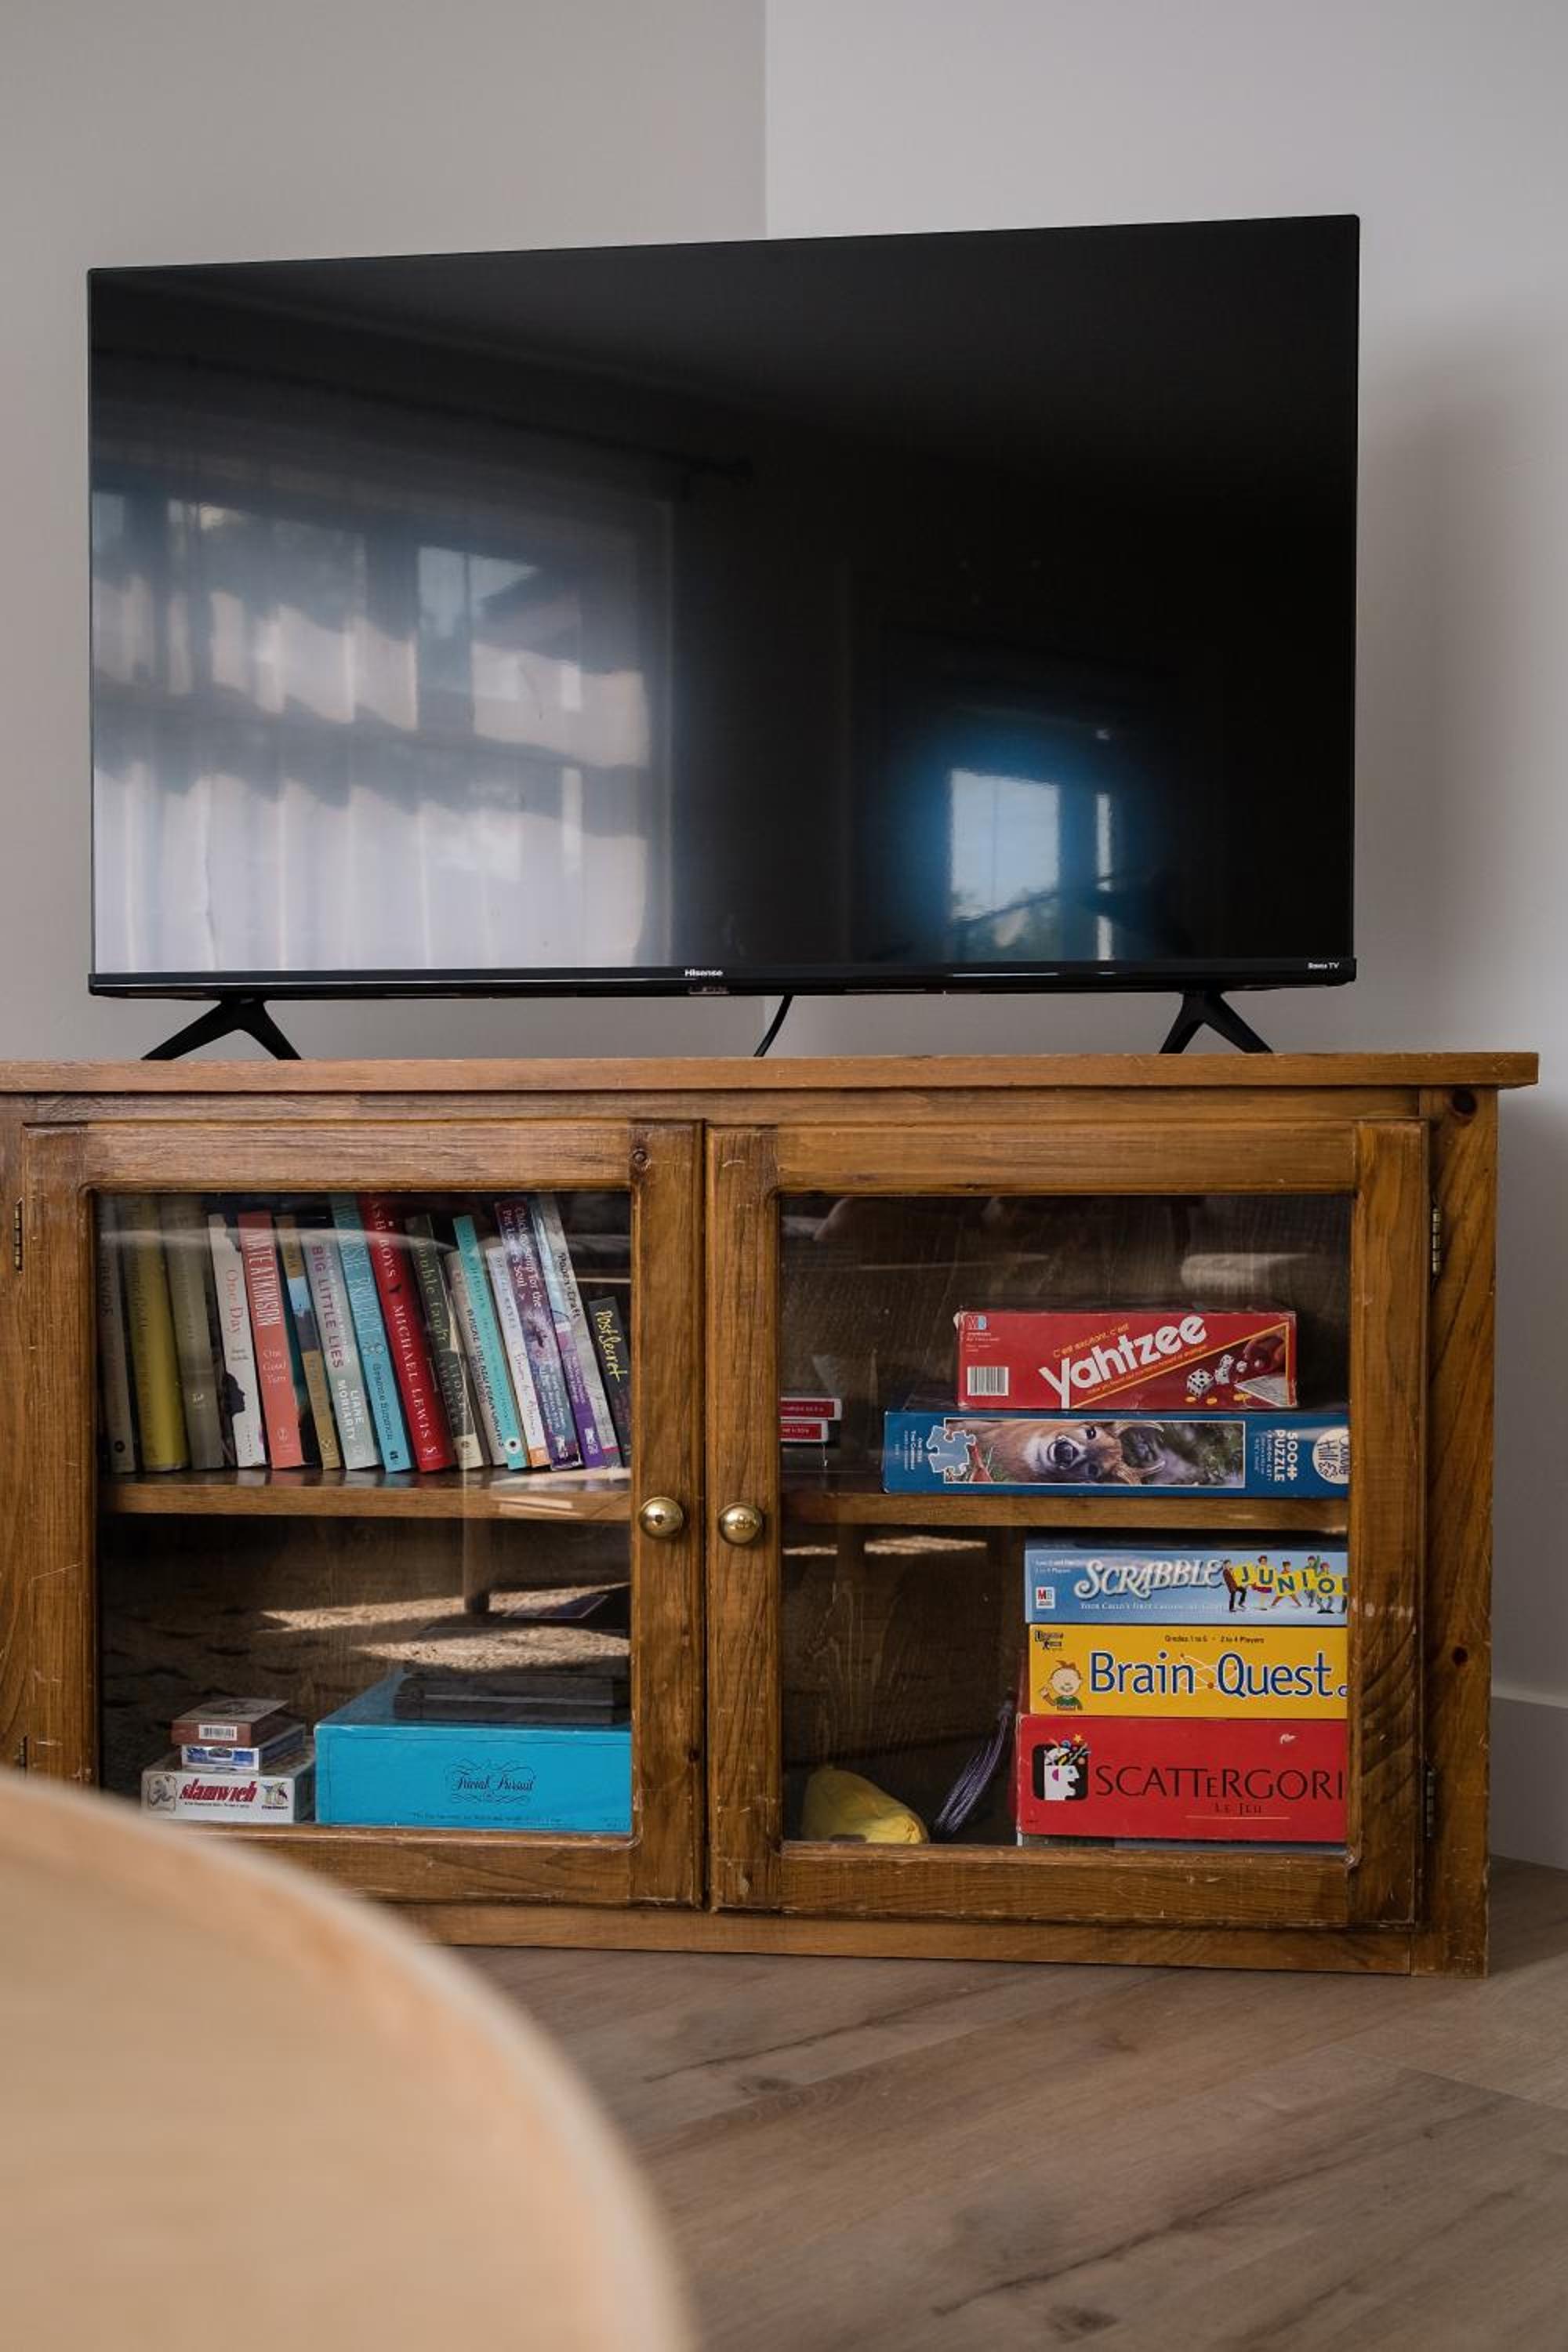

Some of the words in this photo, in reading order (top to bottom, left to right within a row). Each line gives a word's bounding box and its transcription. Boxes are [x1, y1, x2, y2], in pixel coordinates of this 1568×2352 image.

[684, 968, 724, 977] Hisense
[311, 1245, 326, 1272] BIG
[379, 1240, 396, 1277] BOYS
[250, 1263, 282, 1327] ATKINSON
[318, 1279, 337, 1328] LITTLE
[532, 1291, 543, 1308] the
[328, 1335, 344, 1368] LIES
[393, 1304, 418, 1382] MICHAEL
[412, 1388, 430, 1439] LEWIS
[1038, 1315, 1207, 1409] Yahtzee
[337, 1380, 357, 1441] MORIARTY
[350, 1390, 365, 1424] LIANE
[1274, 1429, 1286, 1481] PUZZLE
[1074, 1559, 1223, 1600] SCRABBLE
[1090, 1651, 1195, 1694] Brain
[1218, 1652, 1334, 1699] Quest
[1095, 1766, 1344, 1801] SCATTERGORI
